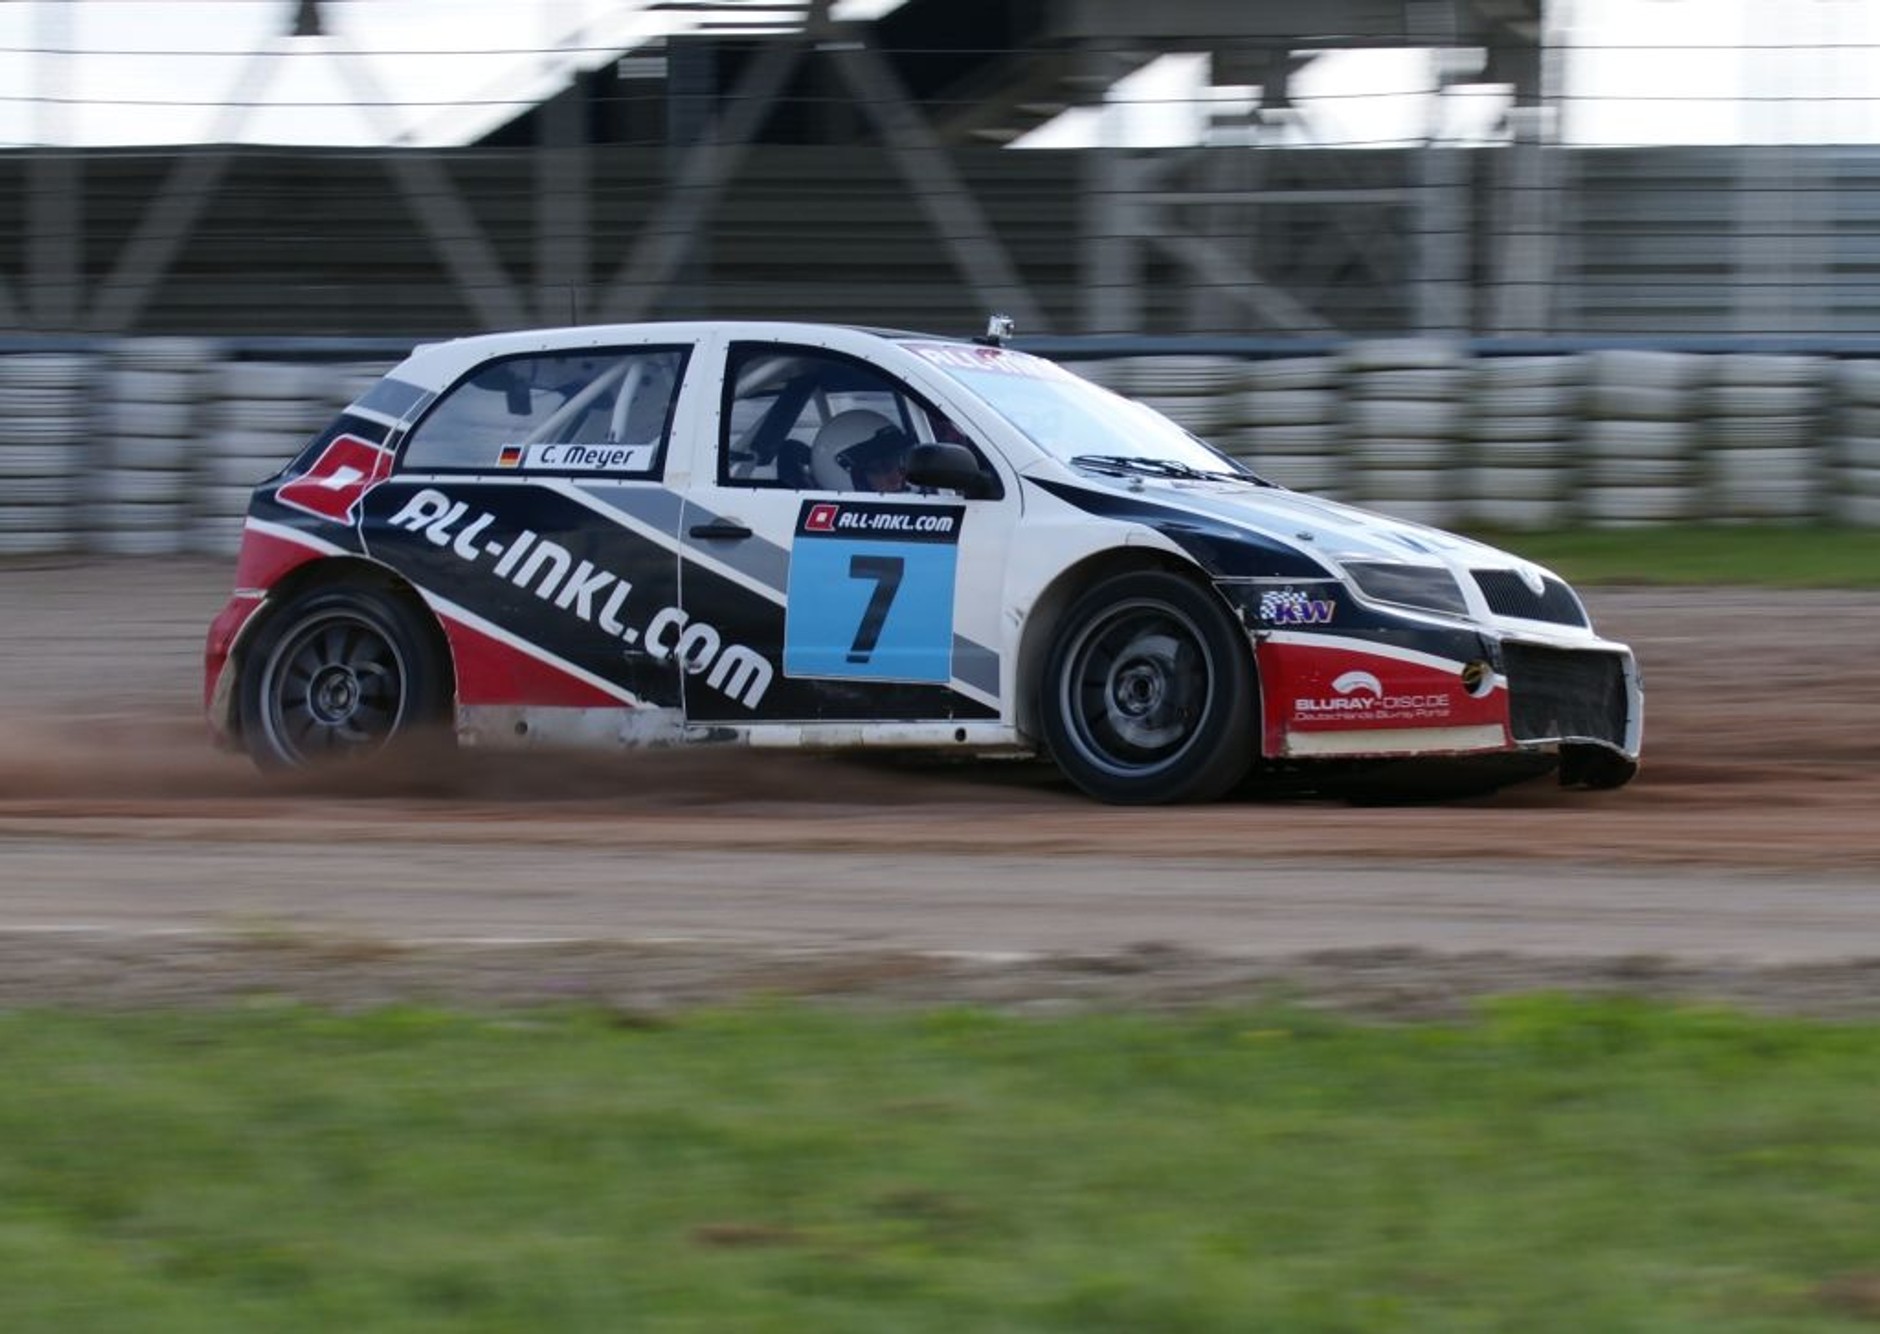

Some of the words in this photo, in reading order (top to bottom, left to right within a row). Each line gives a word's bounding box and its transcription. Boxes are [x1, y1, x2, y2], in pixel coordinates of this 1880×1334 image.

[540, 446, 556, 464] C.
[563, 446, 635, 469] Meyer
[838, 511, 955, 533] ALL-INKL.COM
[387, 488, 774, 711] ALL-INKL.COM
[845, 554, 905, 664] 7
[1273, 599, 1336, 625] KW
[1294, 693, 1450, 711] BLURAY-DISC.DE
